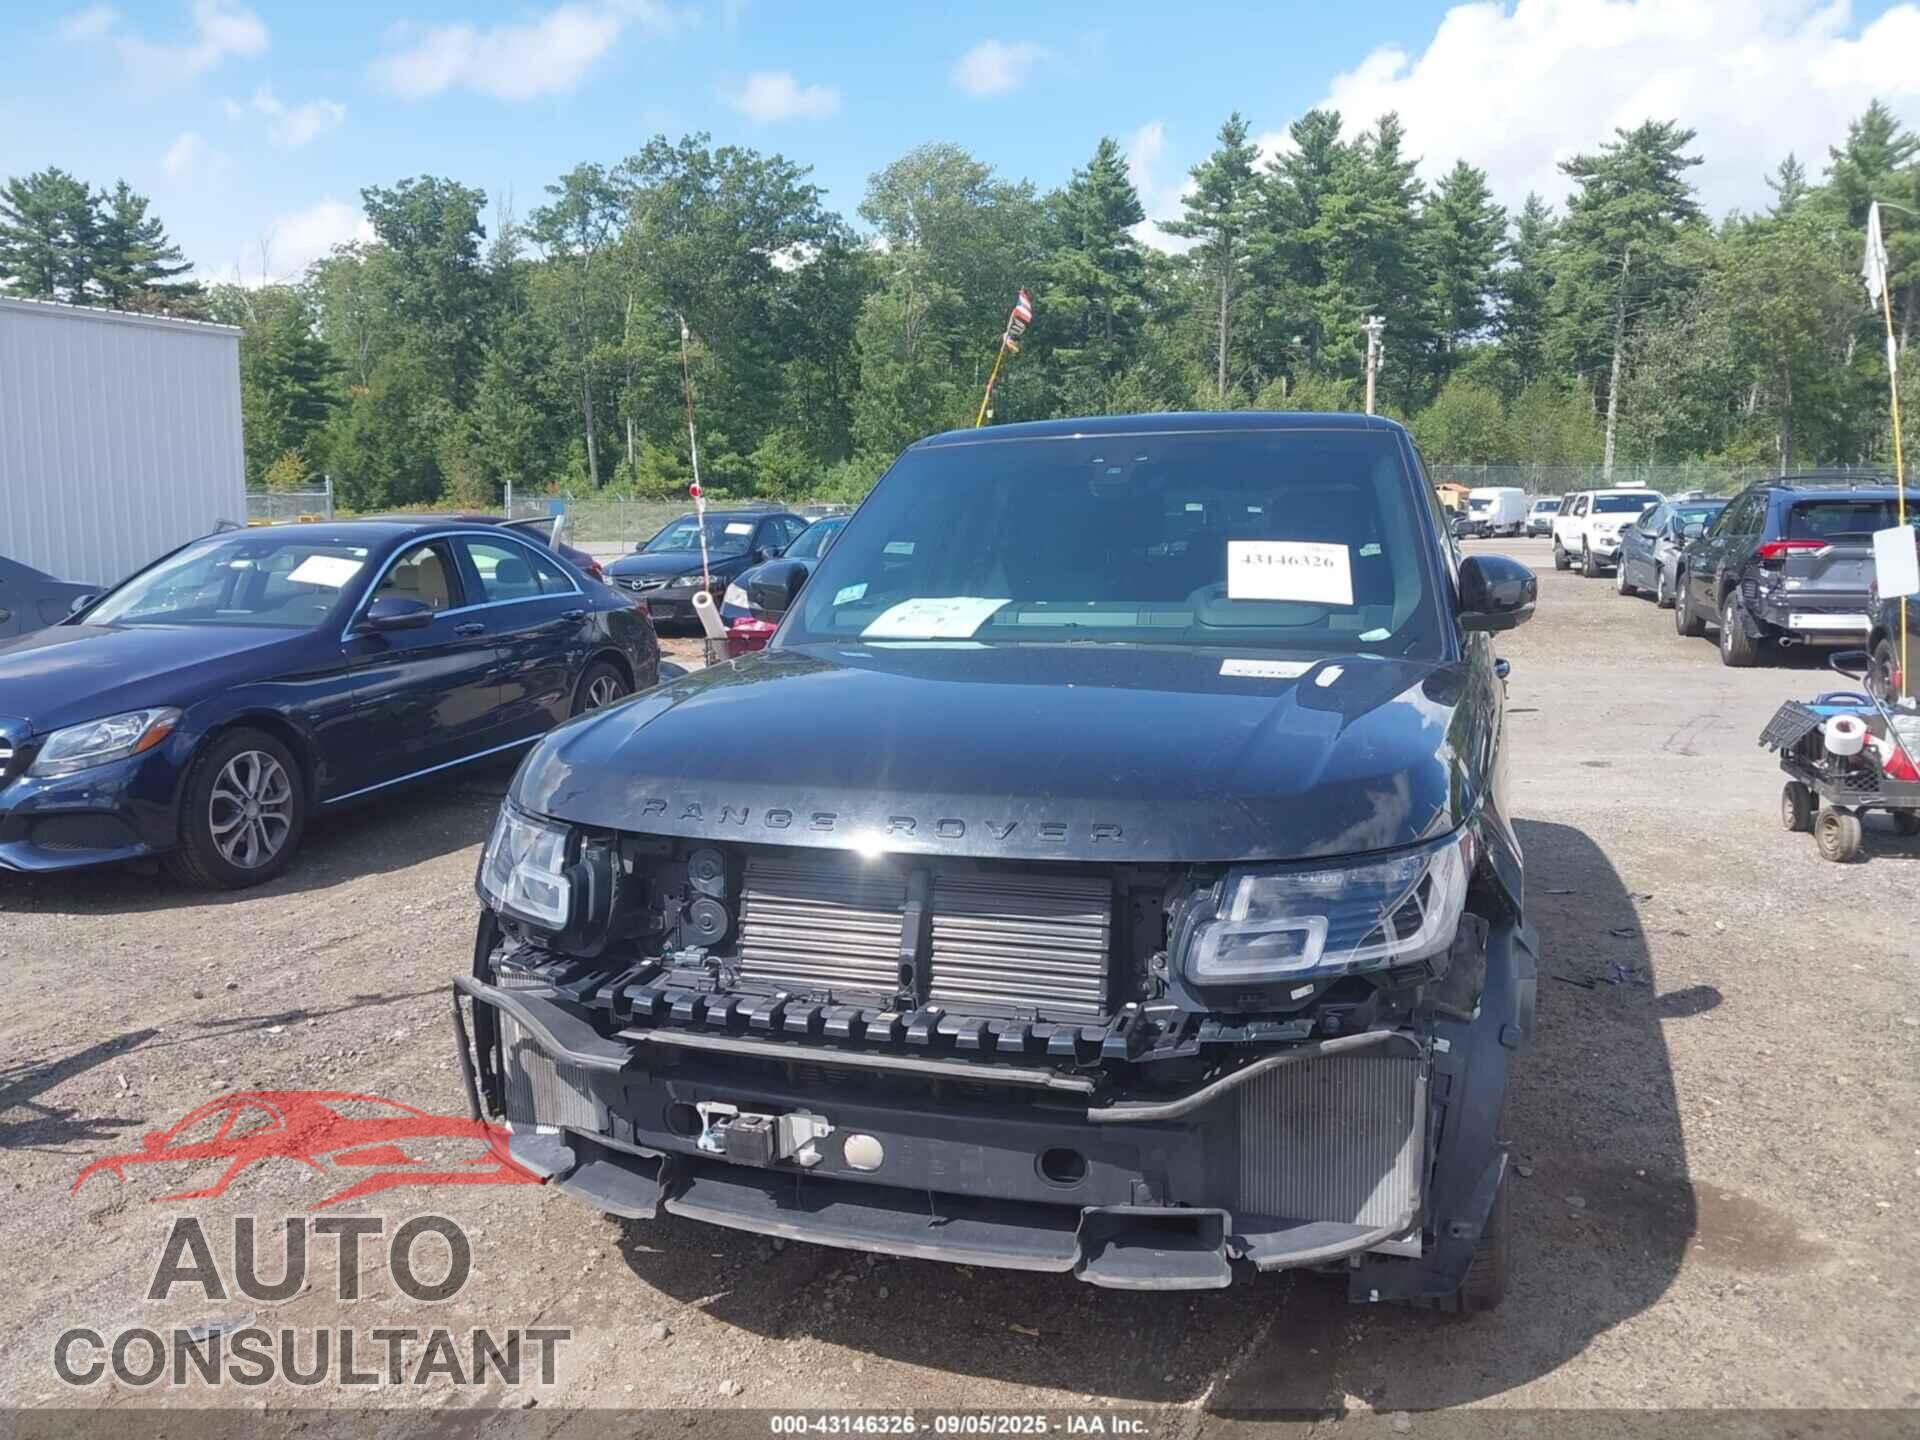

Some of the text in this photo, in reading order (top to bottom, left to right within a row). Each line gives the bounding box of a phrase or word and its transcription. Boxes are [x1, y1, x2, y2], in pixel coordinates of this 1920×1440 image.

[1240, 553, 1335, 568] 43146326
[640, 798, 1124, 844] RANGE ROVER
